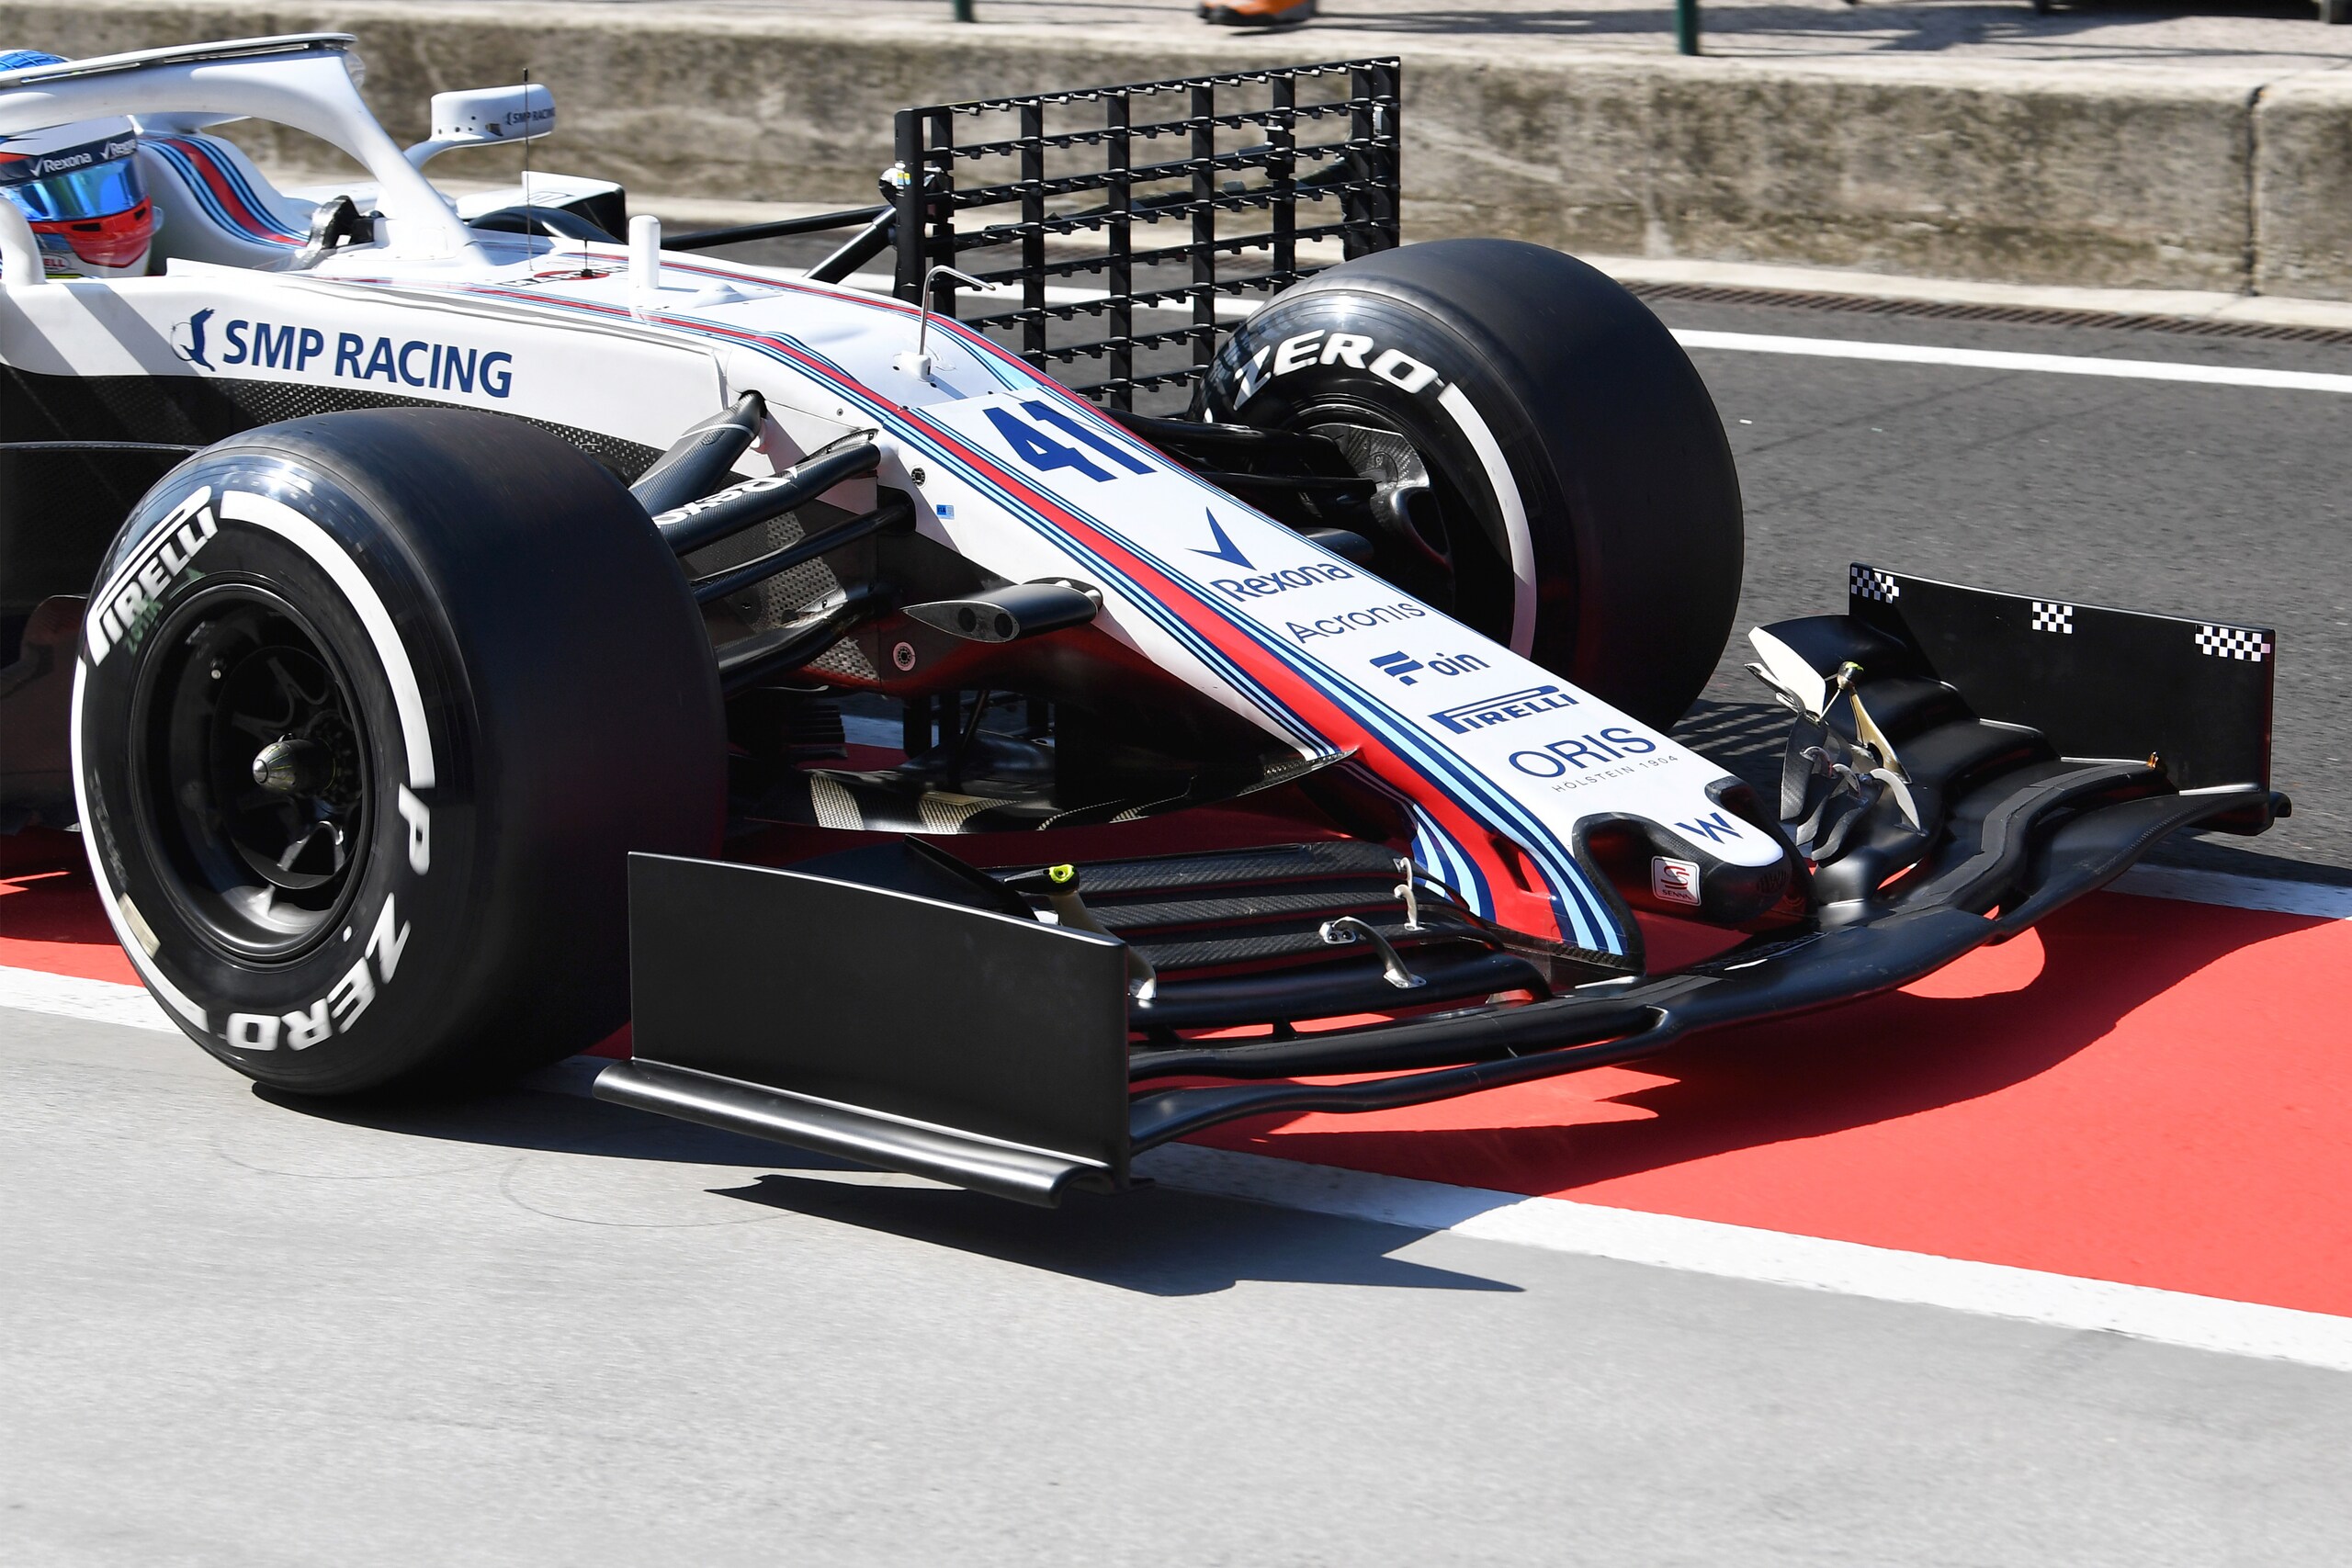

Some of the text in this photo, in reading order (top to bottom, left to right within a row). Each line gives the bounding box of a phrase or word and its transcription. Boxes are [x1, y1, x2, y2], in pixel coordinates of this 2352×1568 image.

[43, 152, 93, 173] Rexona
[222, 320, 513, 398] SMP RACING
[1233, 329, 1439, 411] ZERO
[982, 400, 1159, 482] 41
[86, 485, 219, 667] PIRELLI
[1210, 563, 1355, 603] Rexona
[1285, 603, 1426, 644] Acronis
[1427, 684, 1580, 735] PIRELLI
[1508, 728, 1657, 778] ORIS
[1551, 754, 1679, 793] HÖLSTEIN 1904
[227, 783, 430, 1051] P ZERO
[1662, 889, 1692, 900] SENNA
